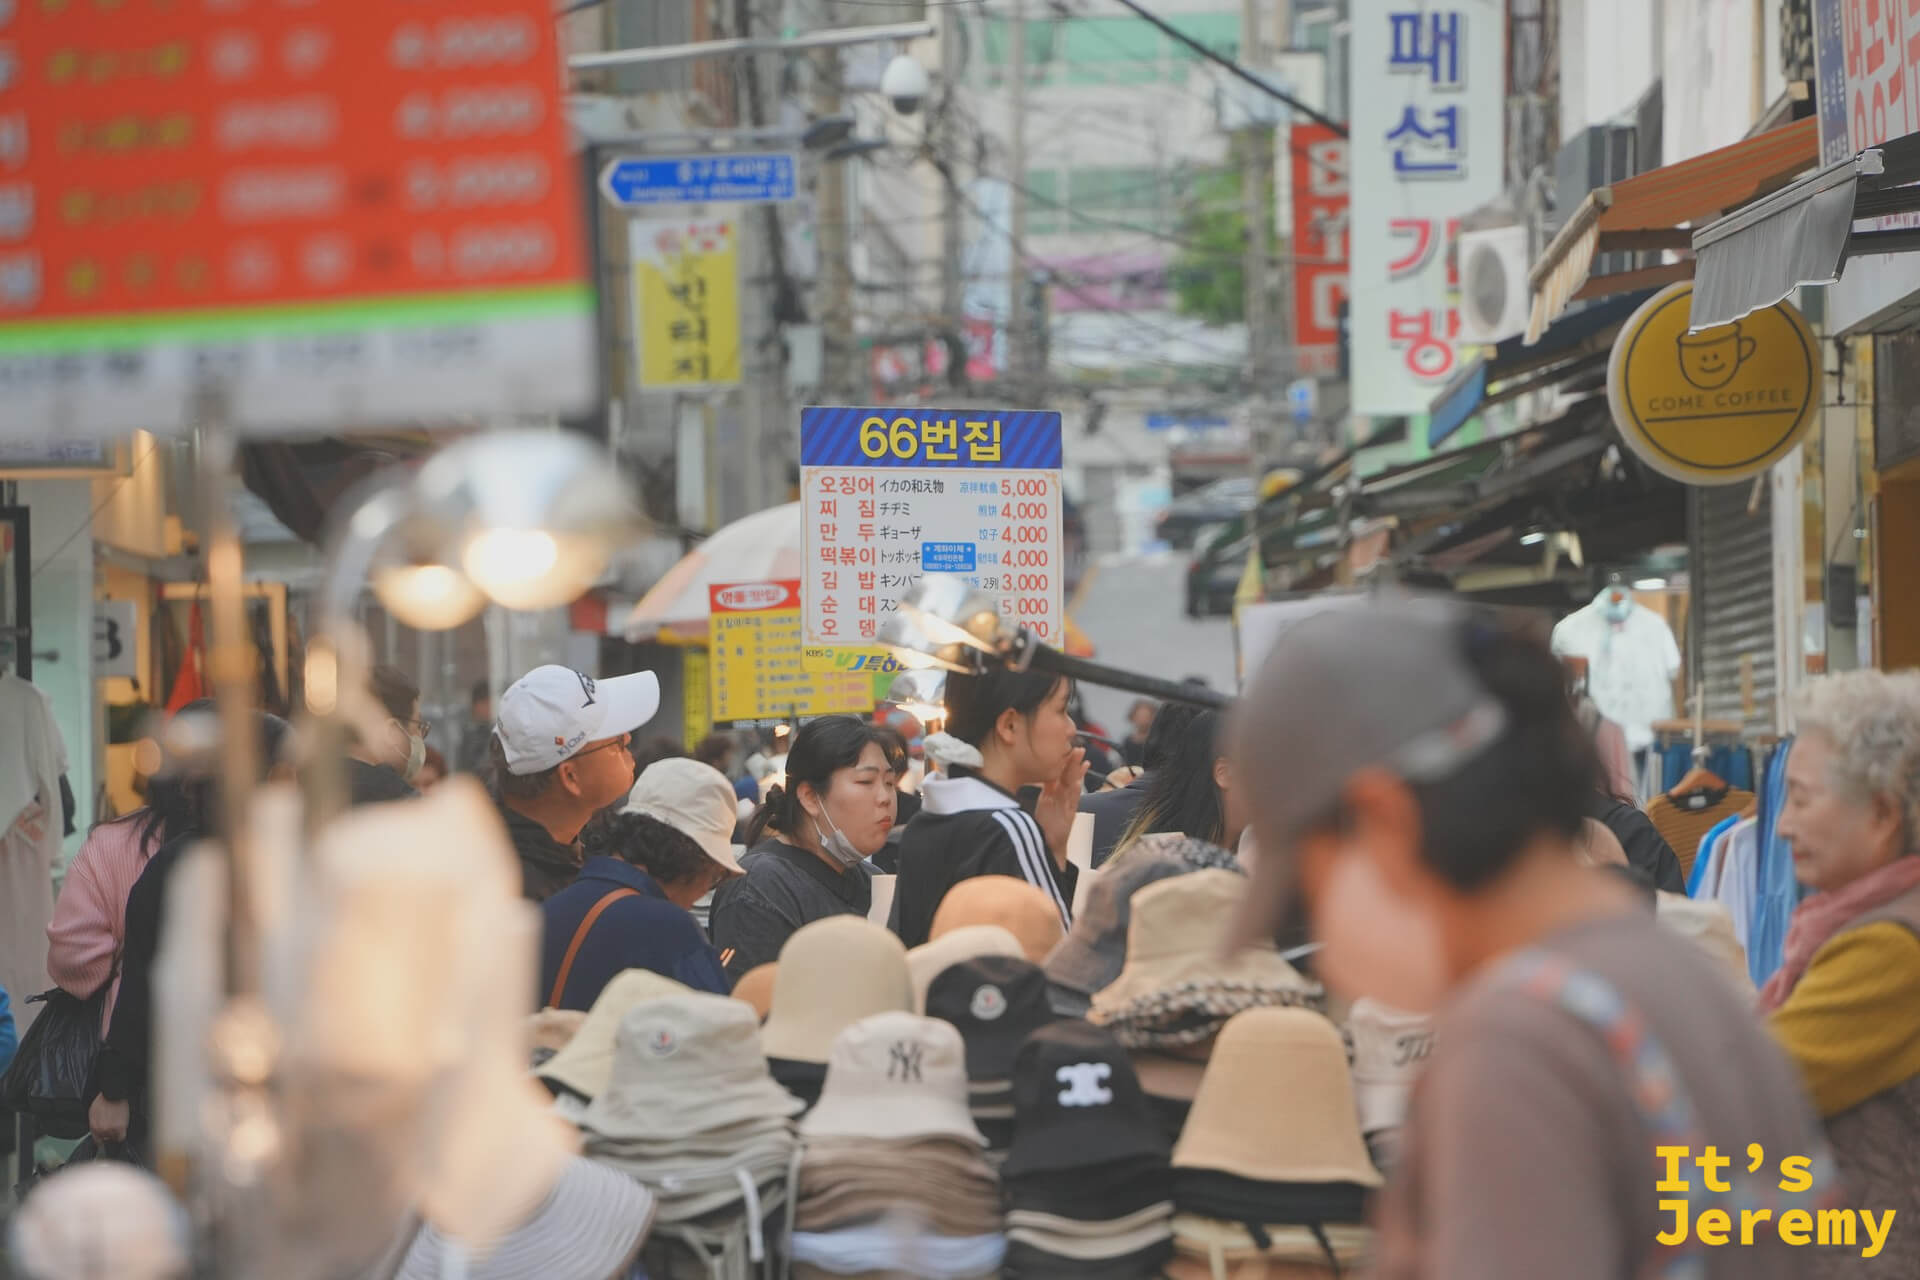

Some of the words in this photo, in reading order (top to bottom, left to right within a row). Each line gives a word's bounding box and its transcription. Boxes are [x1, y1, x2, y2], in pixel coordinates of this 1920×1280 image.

[1649, 394, 1704, 413] COME
[1714, 387, 1793, 408] COFFEE
[859, 416, 1001, 462] 66번집
[819, 476, 875, 496] 오징어
[879, 479, 944, 494] イカの和え物
[1001, 479, 1047, 498] 5,000
[879, 502, 911, 516] チヂミ
[1001, 502, 1048, 521] 4,000
[879, 525, 922, 541] ギョーザ
[1002, 526, 1049, 545] 4,000
[819, 546, 876, 566] 떡볶이
[1002, 550, 1049, 569] 4,000
[1002, 574, 1049, 593] 3,000
[1002, 598, 1049, 618] 5,000
